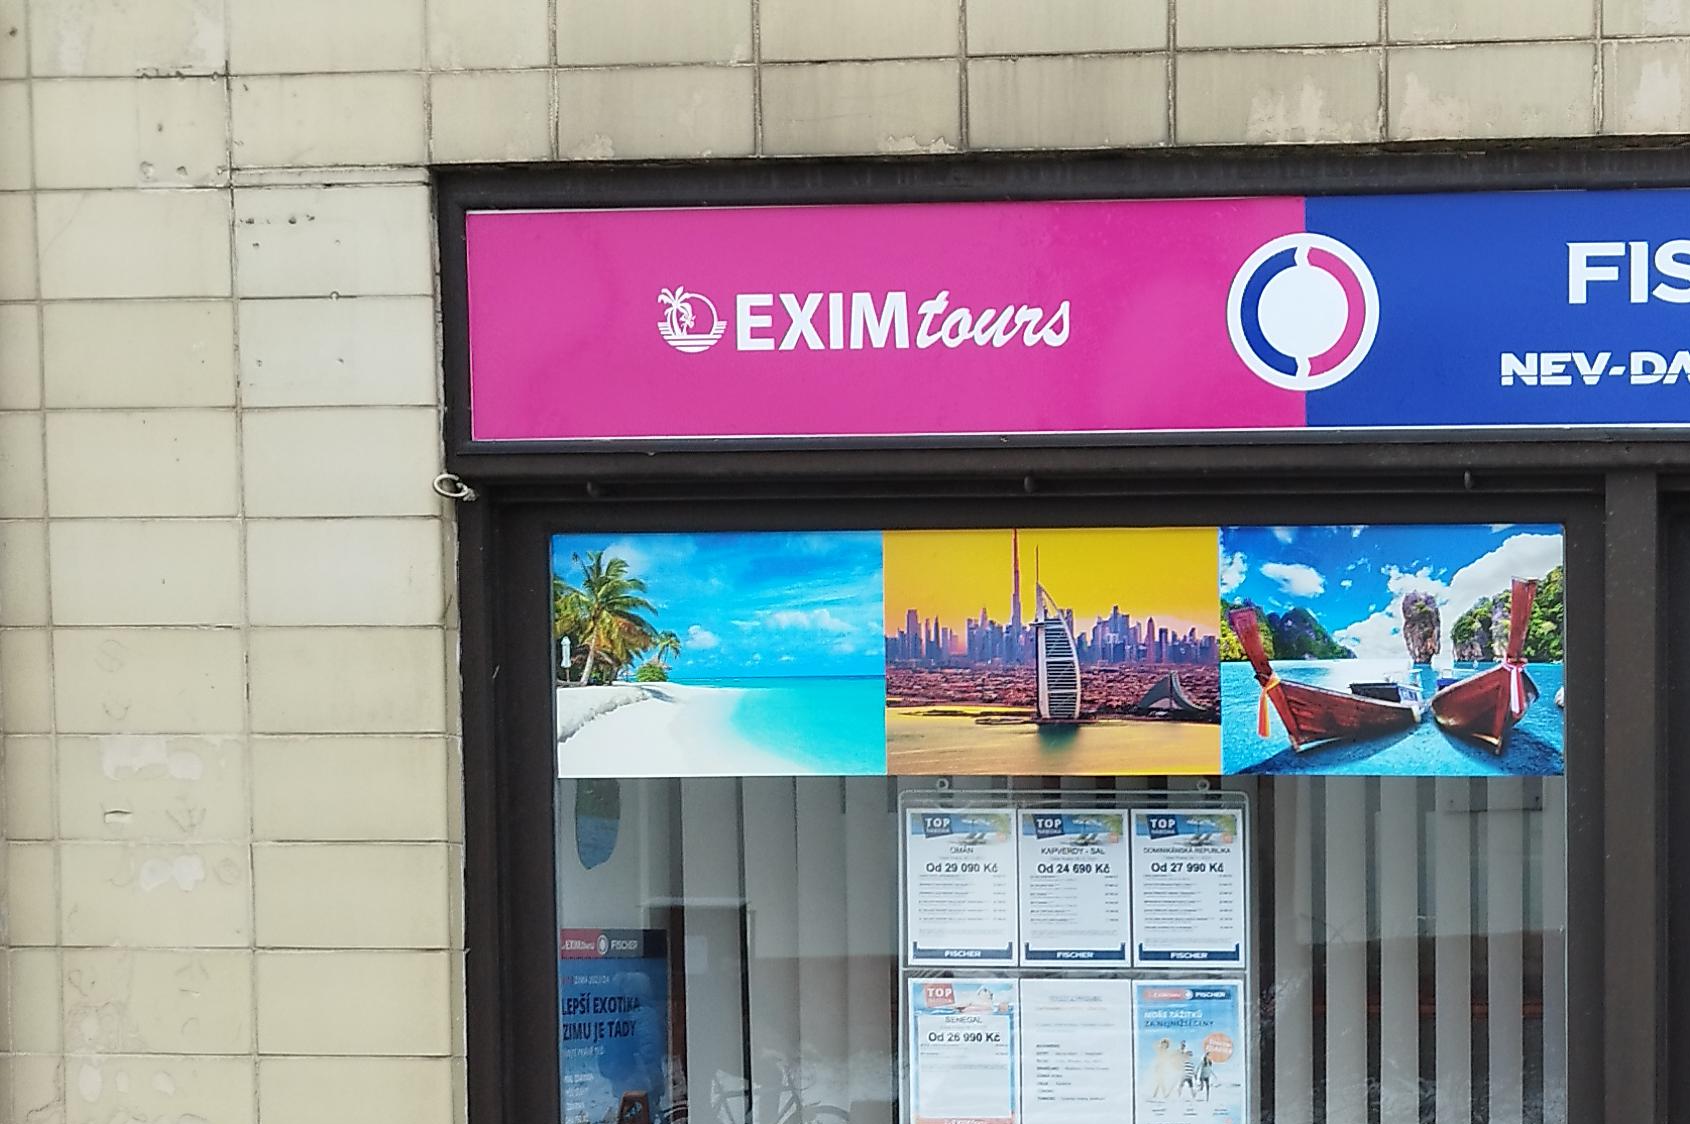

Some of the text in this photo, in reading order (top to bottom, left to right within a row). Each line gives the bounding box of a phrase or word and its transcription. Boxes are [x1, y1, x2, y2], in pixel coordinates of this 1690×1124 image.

[925, 817, 951, 829] TOP
[1036, 818, 1062, 829] TOP
[1149, 818, 1176, 829] TOP
[926, 862, 942, 873] Od
[945, 862, 958, 873] 29
[1037, 863, 1053, 874] Od
[1056, 863, 1070, 874] 24
[1095, 863, 1110, 874] Kč
[1151, 862, 1167, 873] Od
[1170, 862, 1184, 873] 27
[944, 950, 982, 958] FISCHER
[1056, 951, 1094, 959] FISCHER
[927, 988, 952, 998] TOP
[561, 992, 591, 1015] LEPŠÍ
[944, 1015, 983, 1023] SENEGAL
[562, 1020, 637, 1043] ZIMU JE TADY
[928, 1031, 944, 1042] Od
[985, 1031, 1001, 1042] Kč
